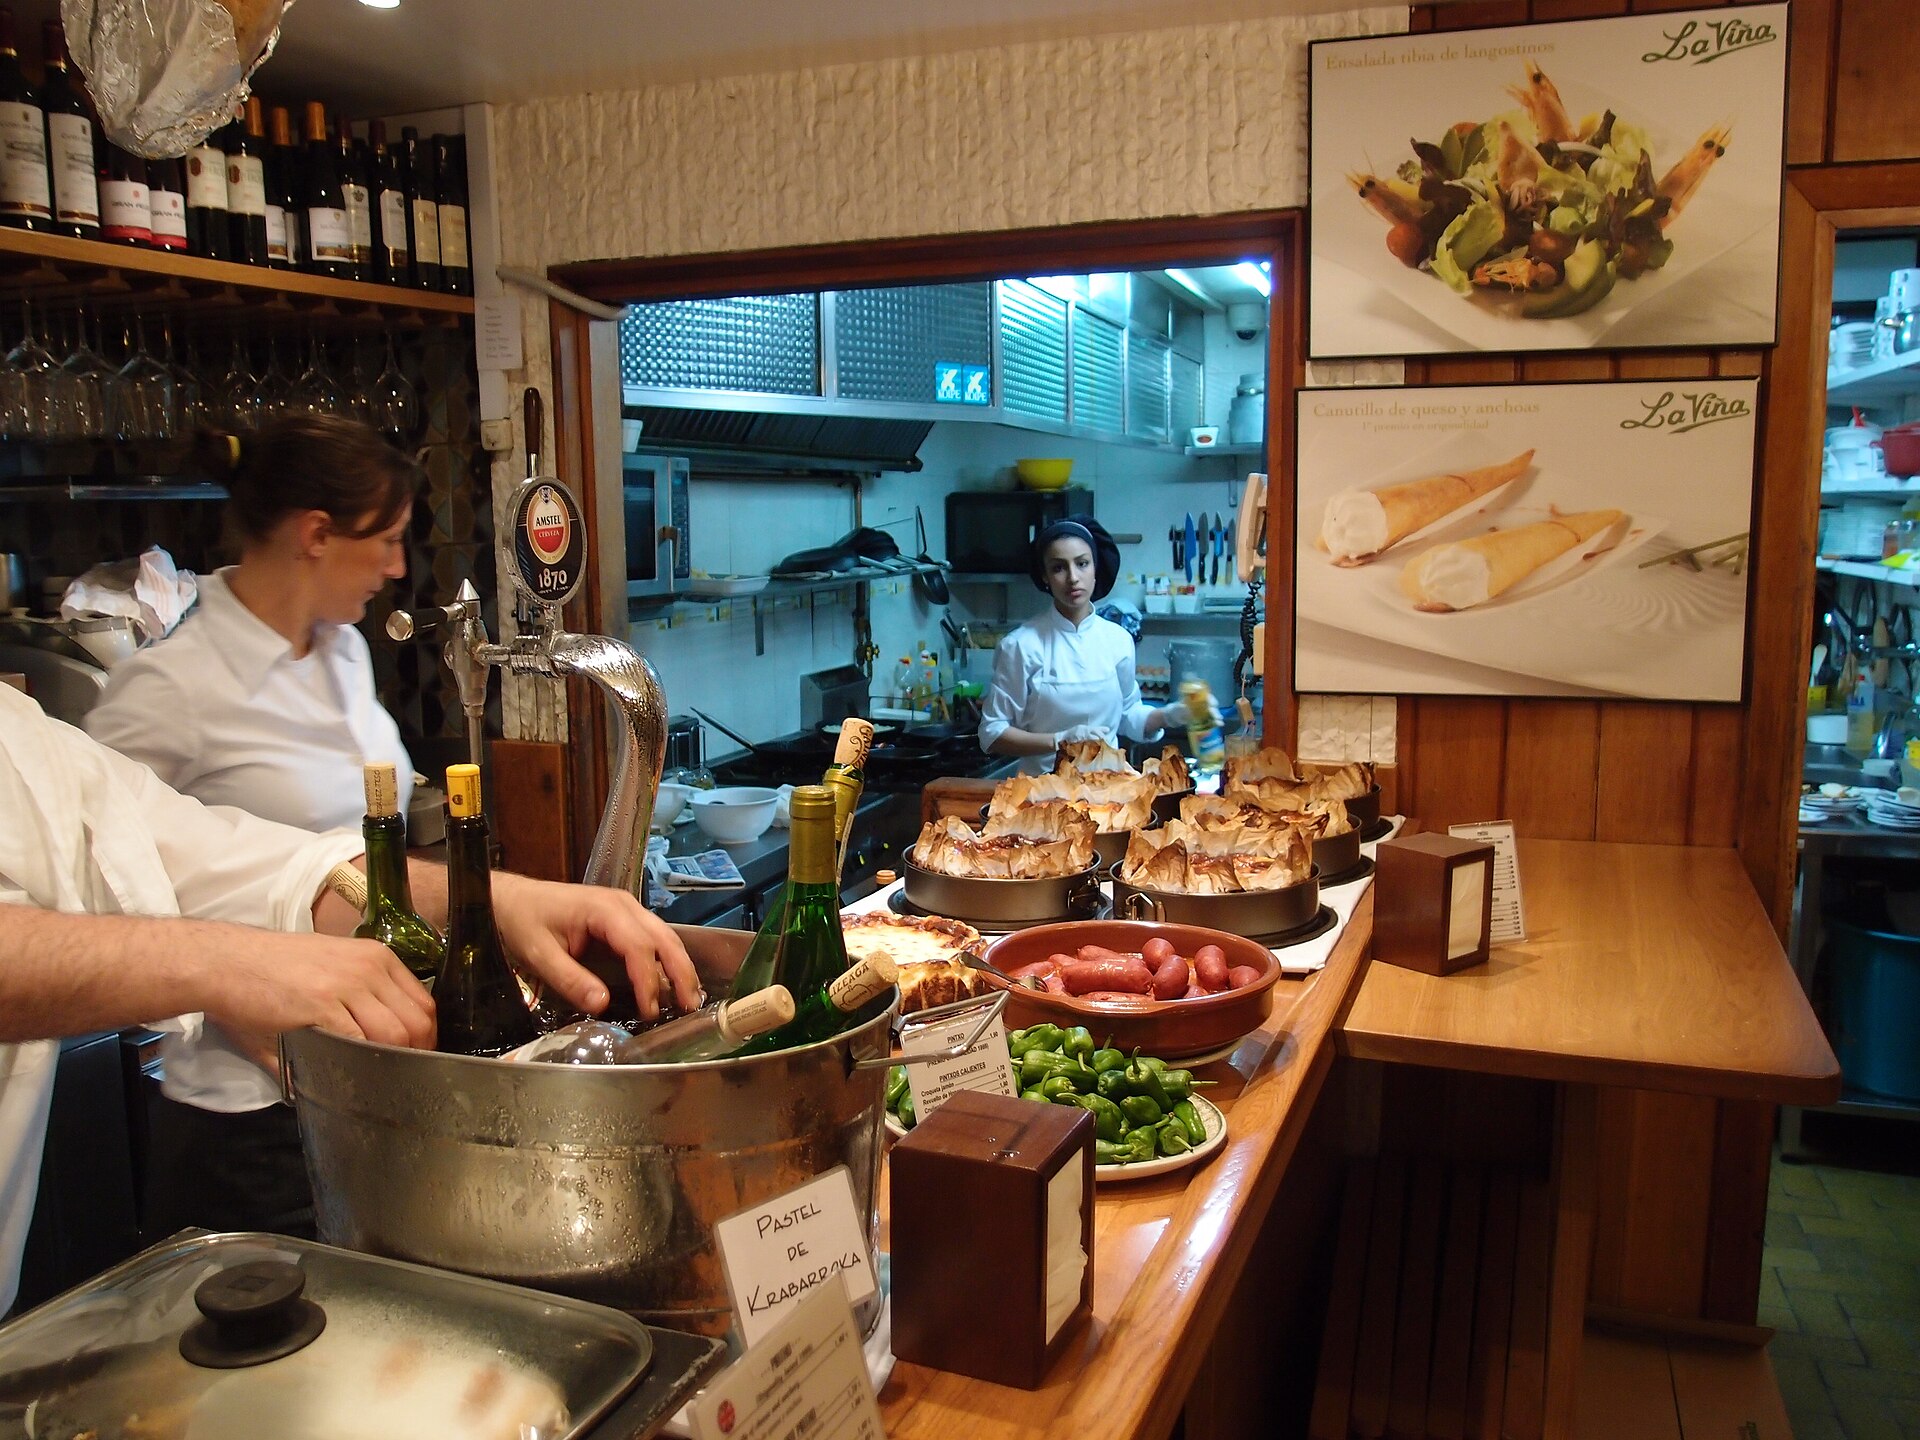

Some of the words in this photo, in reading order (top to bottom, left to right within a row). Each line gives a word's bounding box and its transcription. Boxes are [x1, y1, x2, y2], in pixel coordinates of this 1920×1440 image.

[1641, 20, 1709, 63] La
[1706, 19, 1777, 53] Viña
[1325, 50, 1396, 70] Ensalada
[1400, 47, 1435, 64] tibia
[1440, 45, 1460, 61] de
[1464, 41, 1556, 62] langostinos
[1313, 401, 1384, 417] Canutillo
[1389, 401, 1406, 416] de
[1411, 403, 1457, 418] queso
[1462, 403, 1472, 417] y
[1475, 399, 1541, 414] anchoas
[1620, 391, 1685, 429] La
[1682, 392, 1750, 424] Viña
[535, 515, 561, 527] AMSTEL
[538, 530, 560, 538] CERVEZA
[538, 567, 568, 590] 1870
[947, 1033, 965, 1043] PINTXO
[939, 1070, 960, 1082] PINTXOS
[960, 1062, 986, 1075] CALIENTES
[921, 1087, 941, 1097] Croqueta
[941, 1082, 955, 1092] jamón
[922, 1095, 942, 1106] Revuelto
[756, 1202, 822, 1239] PASTEL
[787, 1241, 809, 1261] DE
